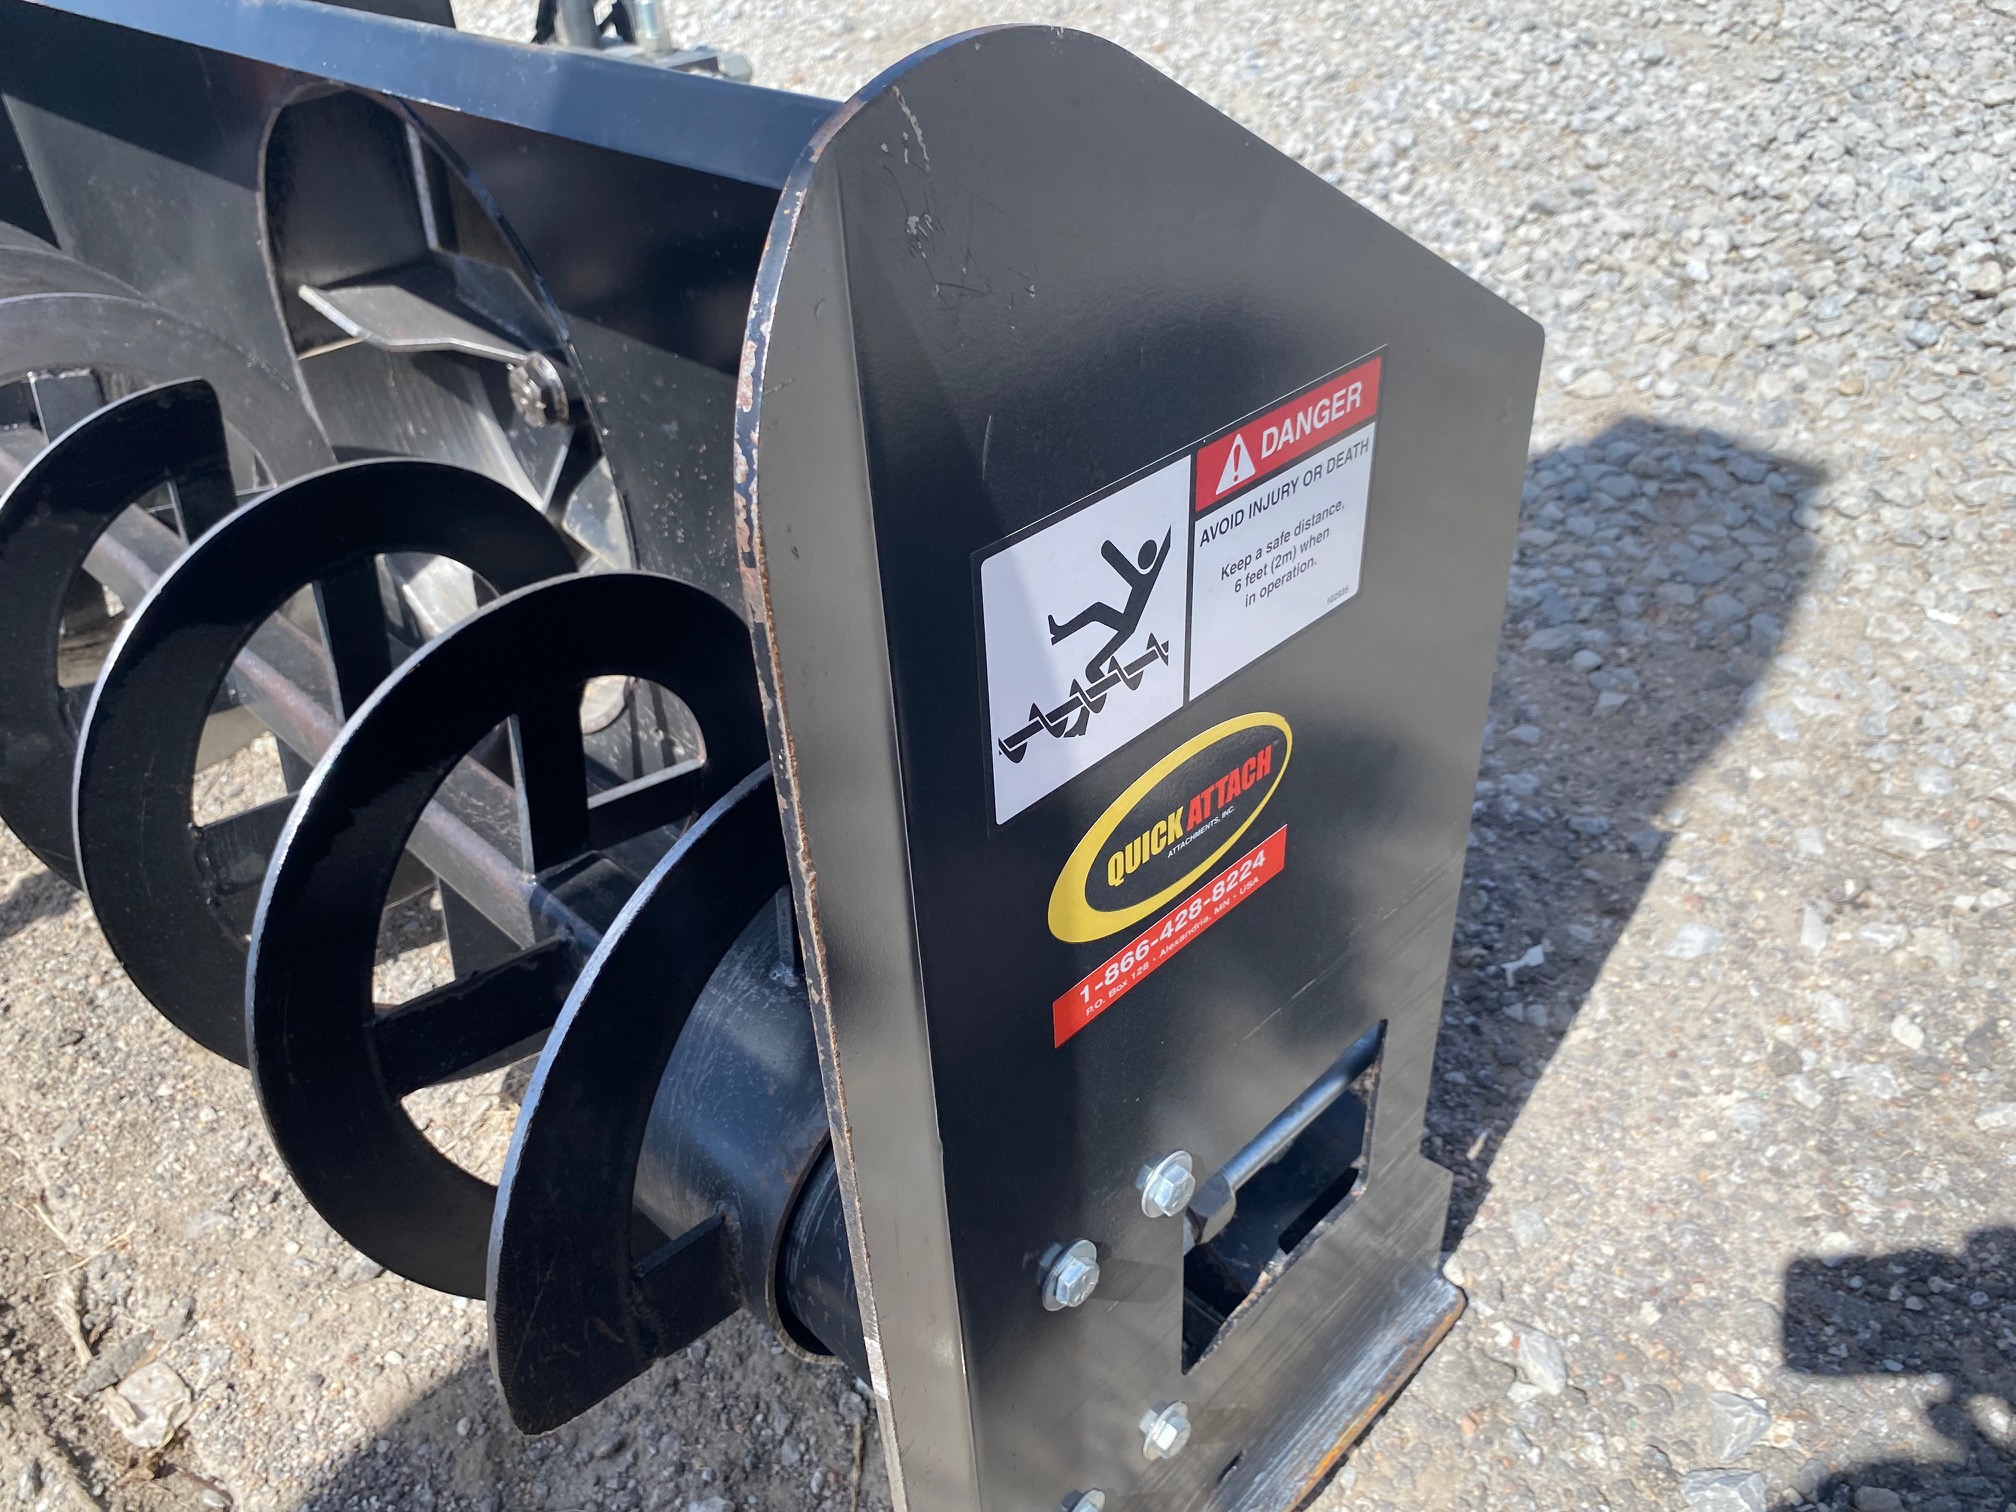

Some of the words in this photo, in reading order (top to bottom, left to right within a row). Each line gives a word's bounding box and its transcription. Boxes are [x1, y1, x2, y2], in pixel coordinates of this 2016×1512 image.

[1261, 381, 1362, 460] DANGER
[1200, 509, 1244, 547] AVOID
[1249, 477, 1299, 519] INJURY
[1303, 464, 1322, 487] OR
[1326, 437, 1369, 475] DEATH
[1221, 554, 1252, 581] Keep
[1255, 547, 1262, 560] a
[1266, 531, 1291, 554] safe
[1294, 501, 1345, 537] distance,
[1234, 578, 1242, 593] 6
[1245, 563, 1268, 587] feet
[1271, 545, 1297, 574] (2m)
[1299, 528, 1330, 554] when
[1245, 592, 1256, 608] in
[1260, 557, 1317, 598] operation.
[1107, 806, 1184, 888] QUICK
[1186, 744, 1272, 832] ATTACH
[1221, 805, 1236, 819] INC.
[1080, 849, 1265, 1004] 1-866-428-8224
[1086, 998, 1106, 1016] P.O.
[1109, 979, 1128, 999] Box
[1131, 961, 1150, 979] 128
[1159, 916, 1212, 958] Alexandria,
[1214, 898, 1231, 915] MN
[1240, 876, 1259, 895] USA
